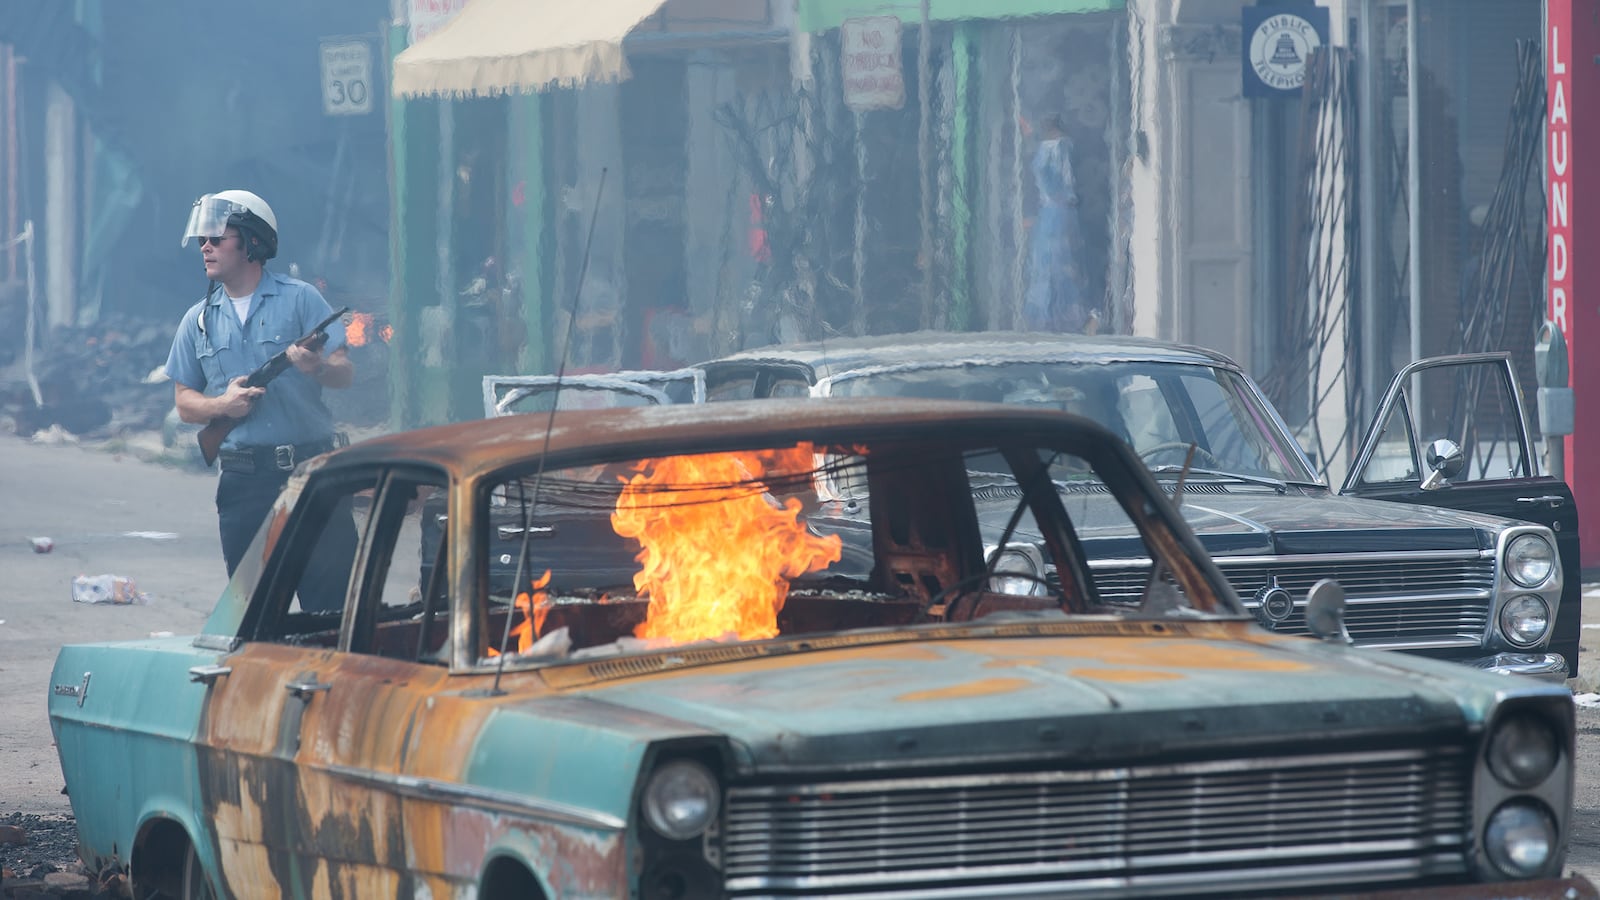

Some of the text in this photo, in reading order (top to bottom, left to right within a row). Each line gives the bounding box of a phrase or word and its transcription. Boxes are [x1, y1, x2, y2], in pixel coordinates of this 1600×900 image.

[1261, 16, 1309, 35] PUBLIC
[1255, 60, 1306, 87] TELEPHO
[332, 80, 367, 105] 30
[1551, 26, 1568, 346] LAUNDR
